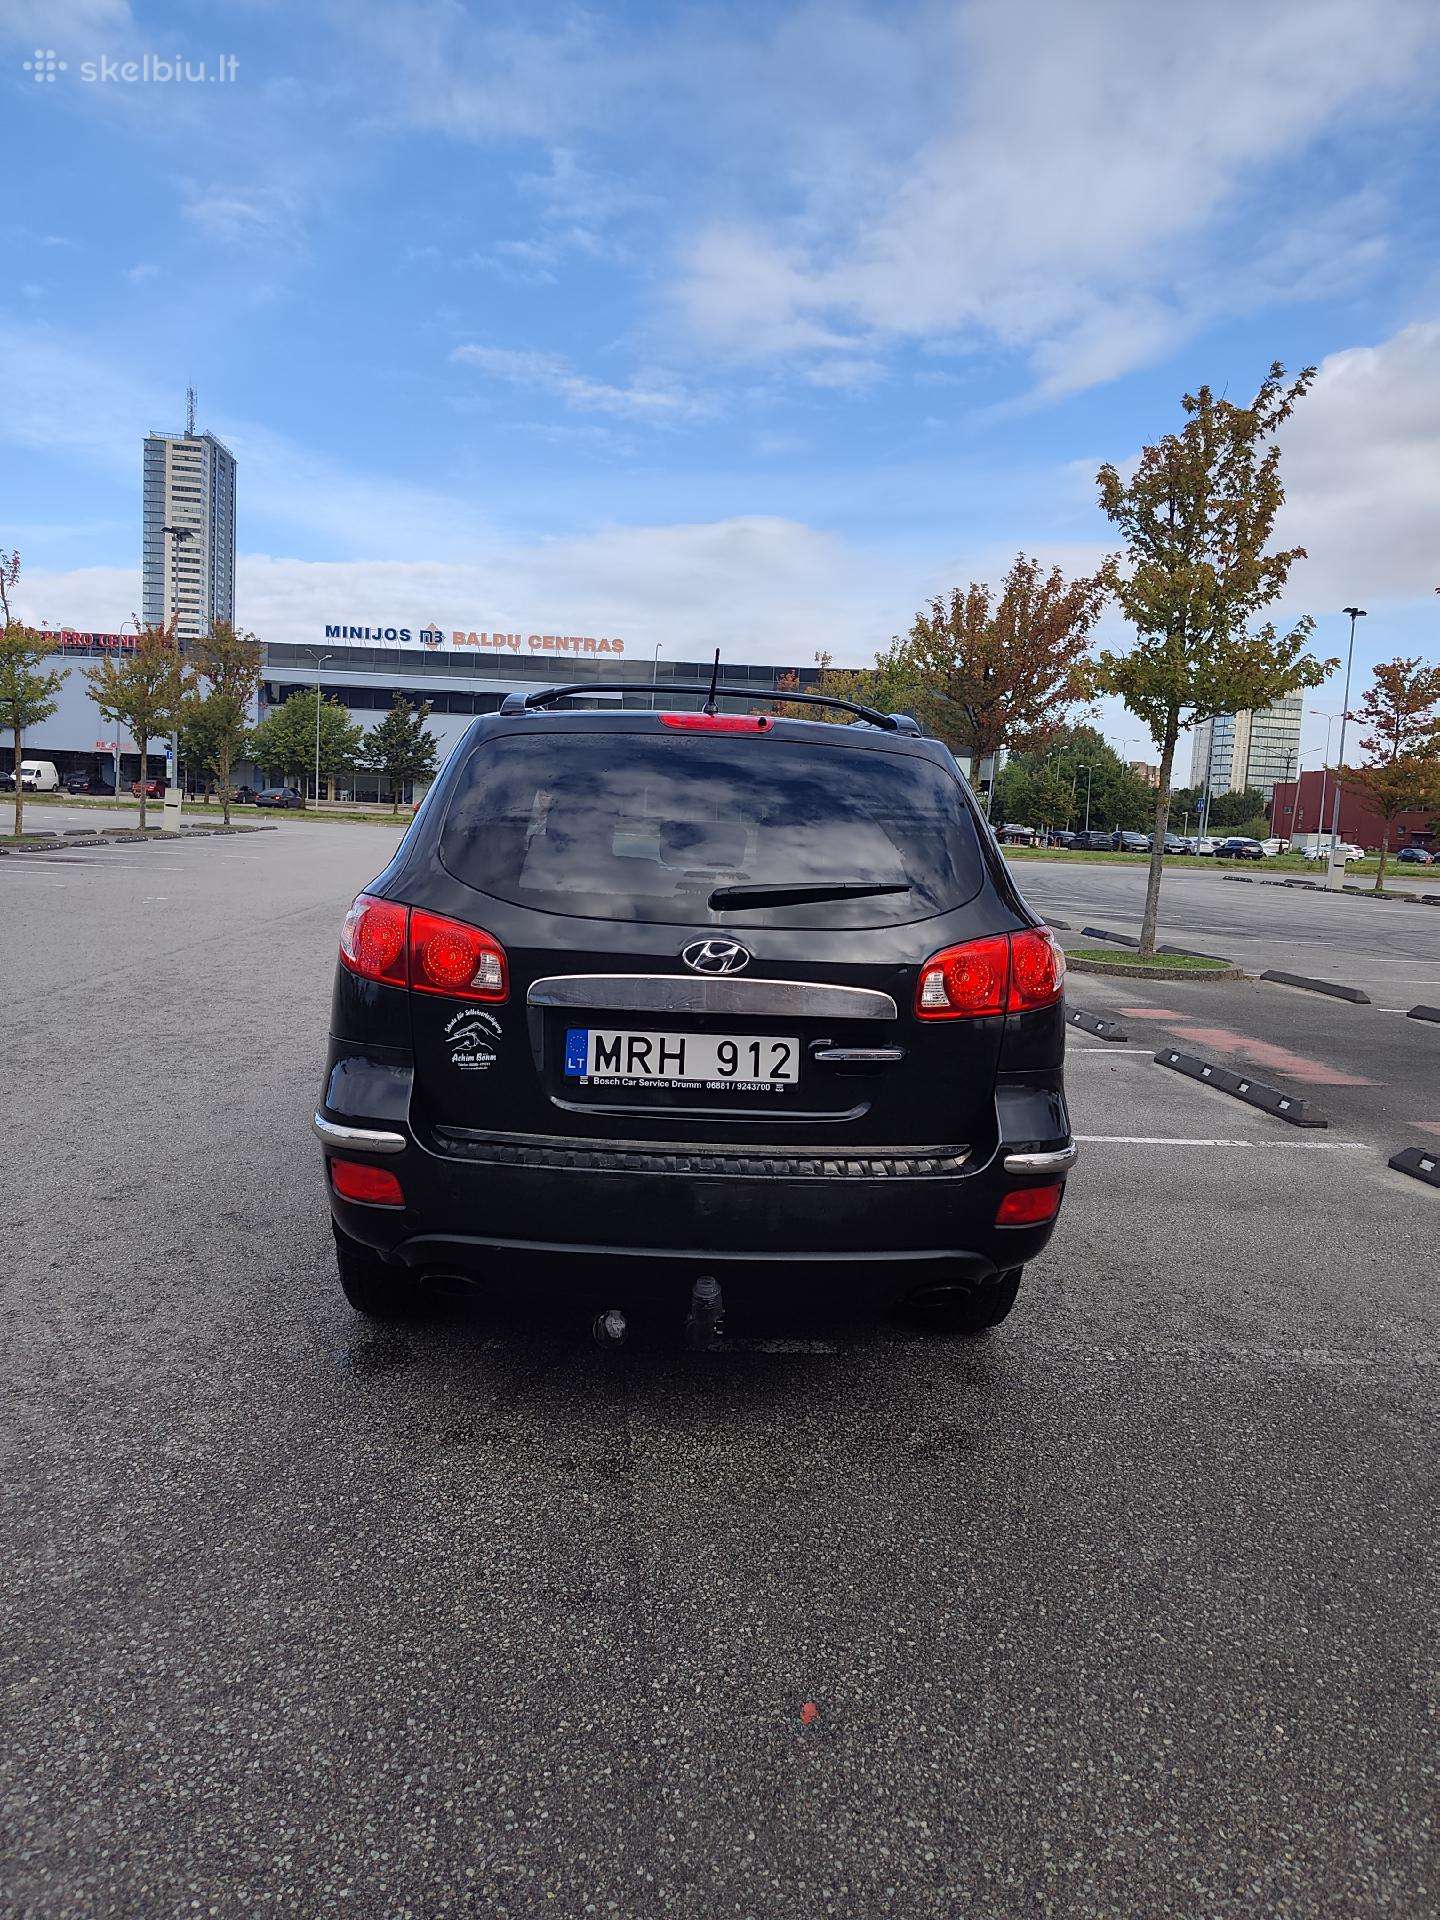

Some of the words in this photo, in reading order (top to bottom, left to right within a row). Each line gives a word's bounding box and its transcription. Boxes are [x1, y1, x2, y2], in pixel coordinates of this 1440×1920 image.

[325, 625, 411, 642] MINIJOS
[528, 635, 625, 653] CENTRAS
[451, 1053, 475, 1063] Achim
[475, 1052, 497, 1062] Böhm
[567, 1057, 585, 1069] LT
[594, 1035, 686, 1076] MRH
[717, 1040, 791, 1079] 912
[593, 1076, 620, 1086] Bosch
[622, 1078, 637, 1087] Car
[638, 1079, 669, 1088] Service
[671, 1080, 702, 1089] Drumm
[736, 1082, 771, 1091] 9243700
